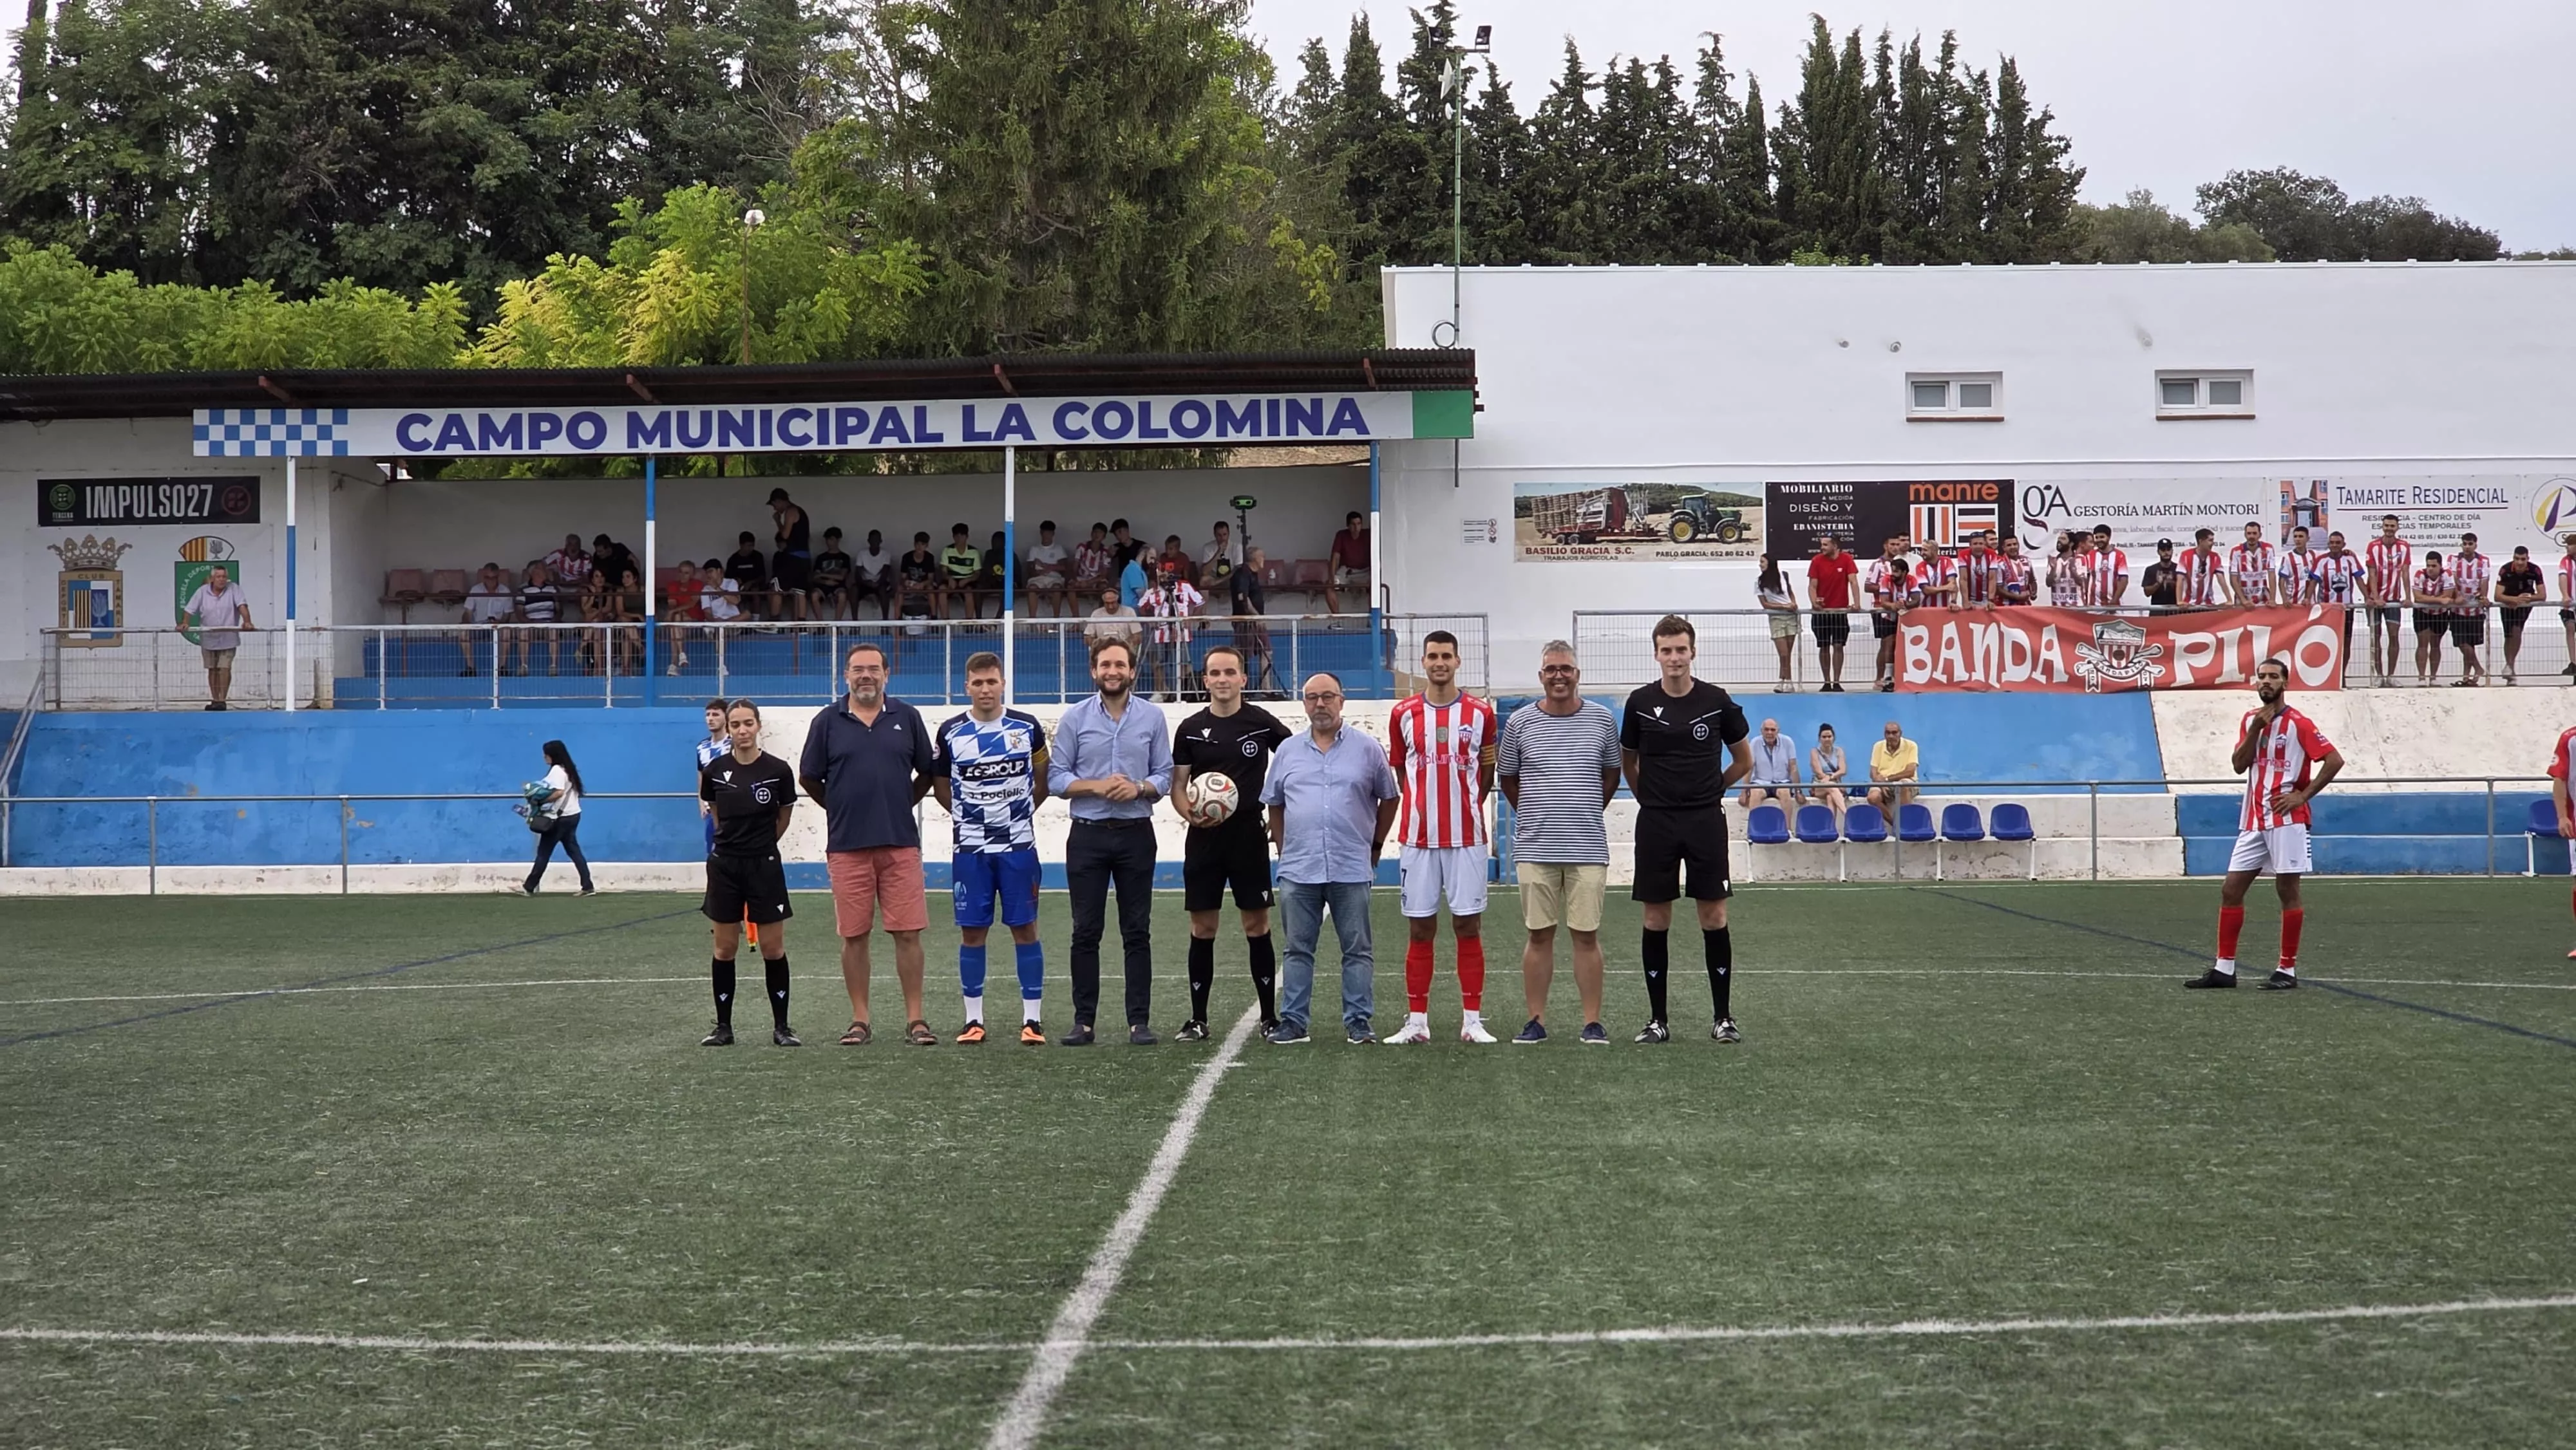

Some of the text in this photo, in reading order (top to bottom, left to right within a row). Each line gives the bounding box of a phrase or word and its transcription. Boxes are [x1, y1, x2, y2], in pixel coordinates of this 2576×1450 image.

[396, 397, 1370, 451] CAMPO MUNICIPAL LA COLOMINA
[1781, 484, 1853, 493] MOBILIARIO
[1909, 483, 1999, 501] manre
[86, 484, 213, 518] IMPULSO27
[1790, 502, 1853, 513] DISEÑO Y
[2074, 502, 2259, 516] GESTORÍA MARTÍN MONTORI
[1902, 620, 2069, 688] BANDA
